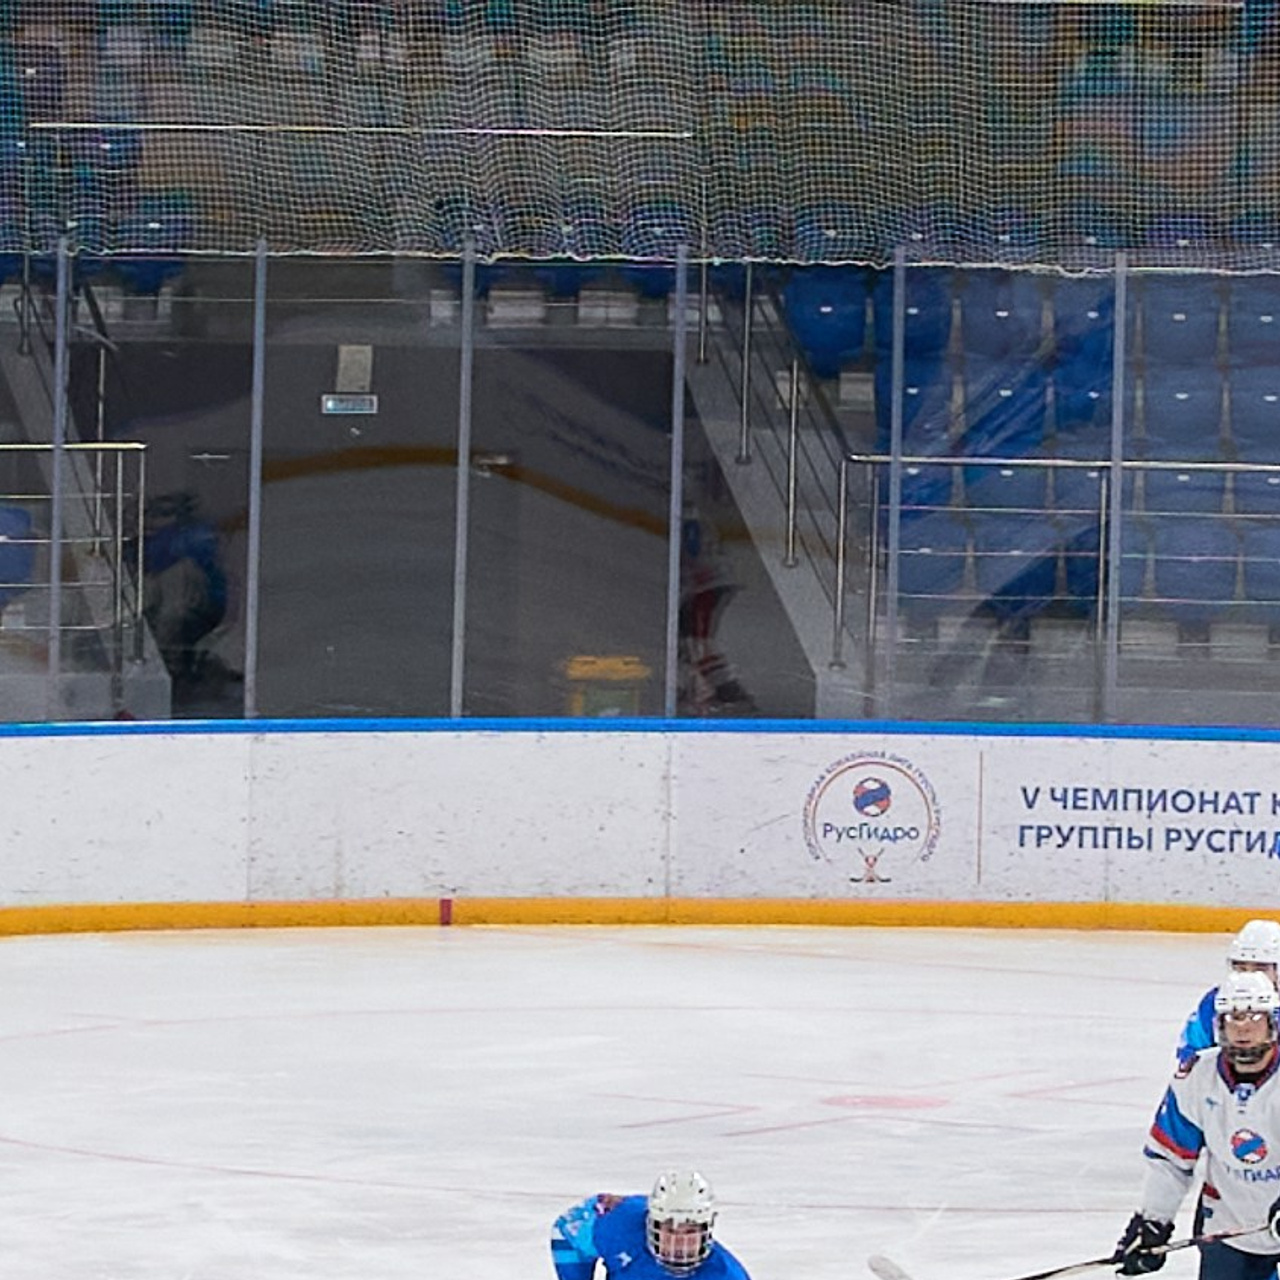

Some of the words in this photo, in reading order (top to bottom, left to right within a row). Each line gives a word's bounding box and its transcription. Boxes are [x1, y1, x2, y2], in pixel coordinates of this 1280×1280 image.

[1020, 786, 1040, 809] V
[1050, 787, 1261, 815] ЧЕМПИОНАТ
[822, 822, 920, 844] РусГидро
[1018, 825, 1154, 850] ГРУППЫ
